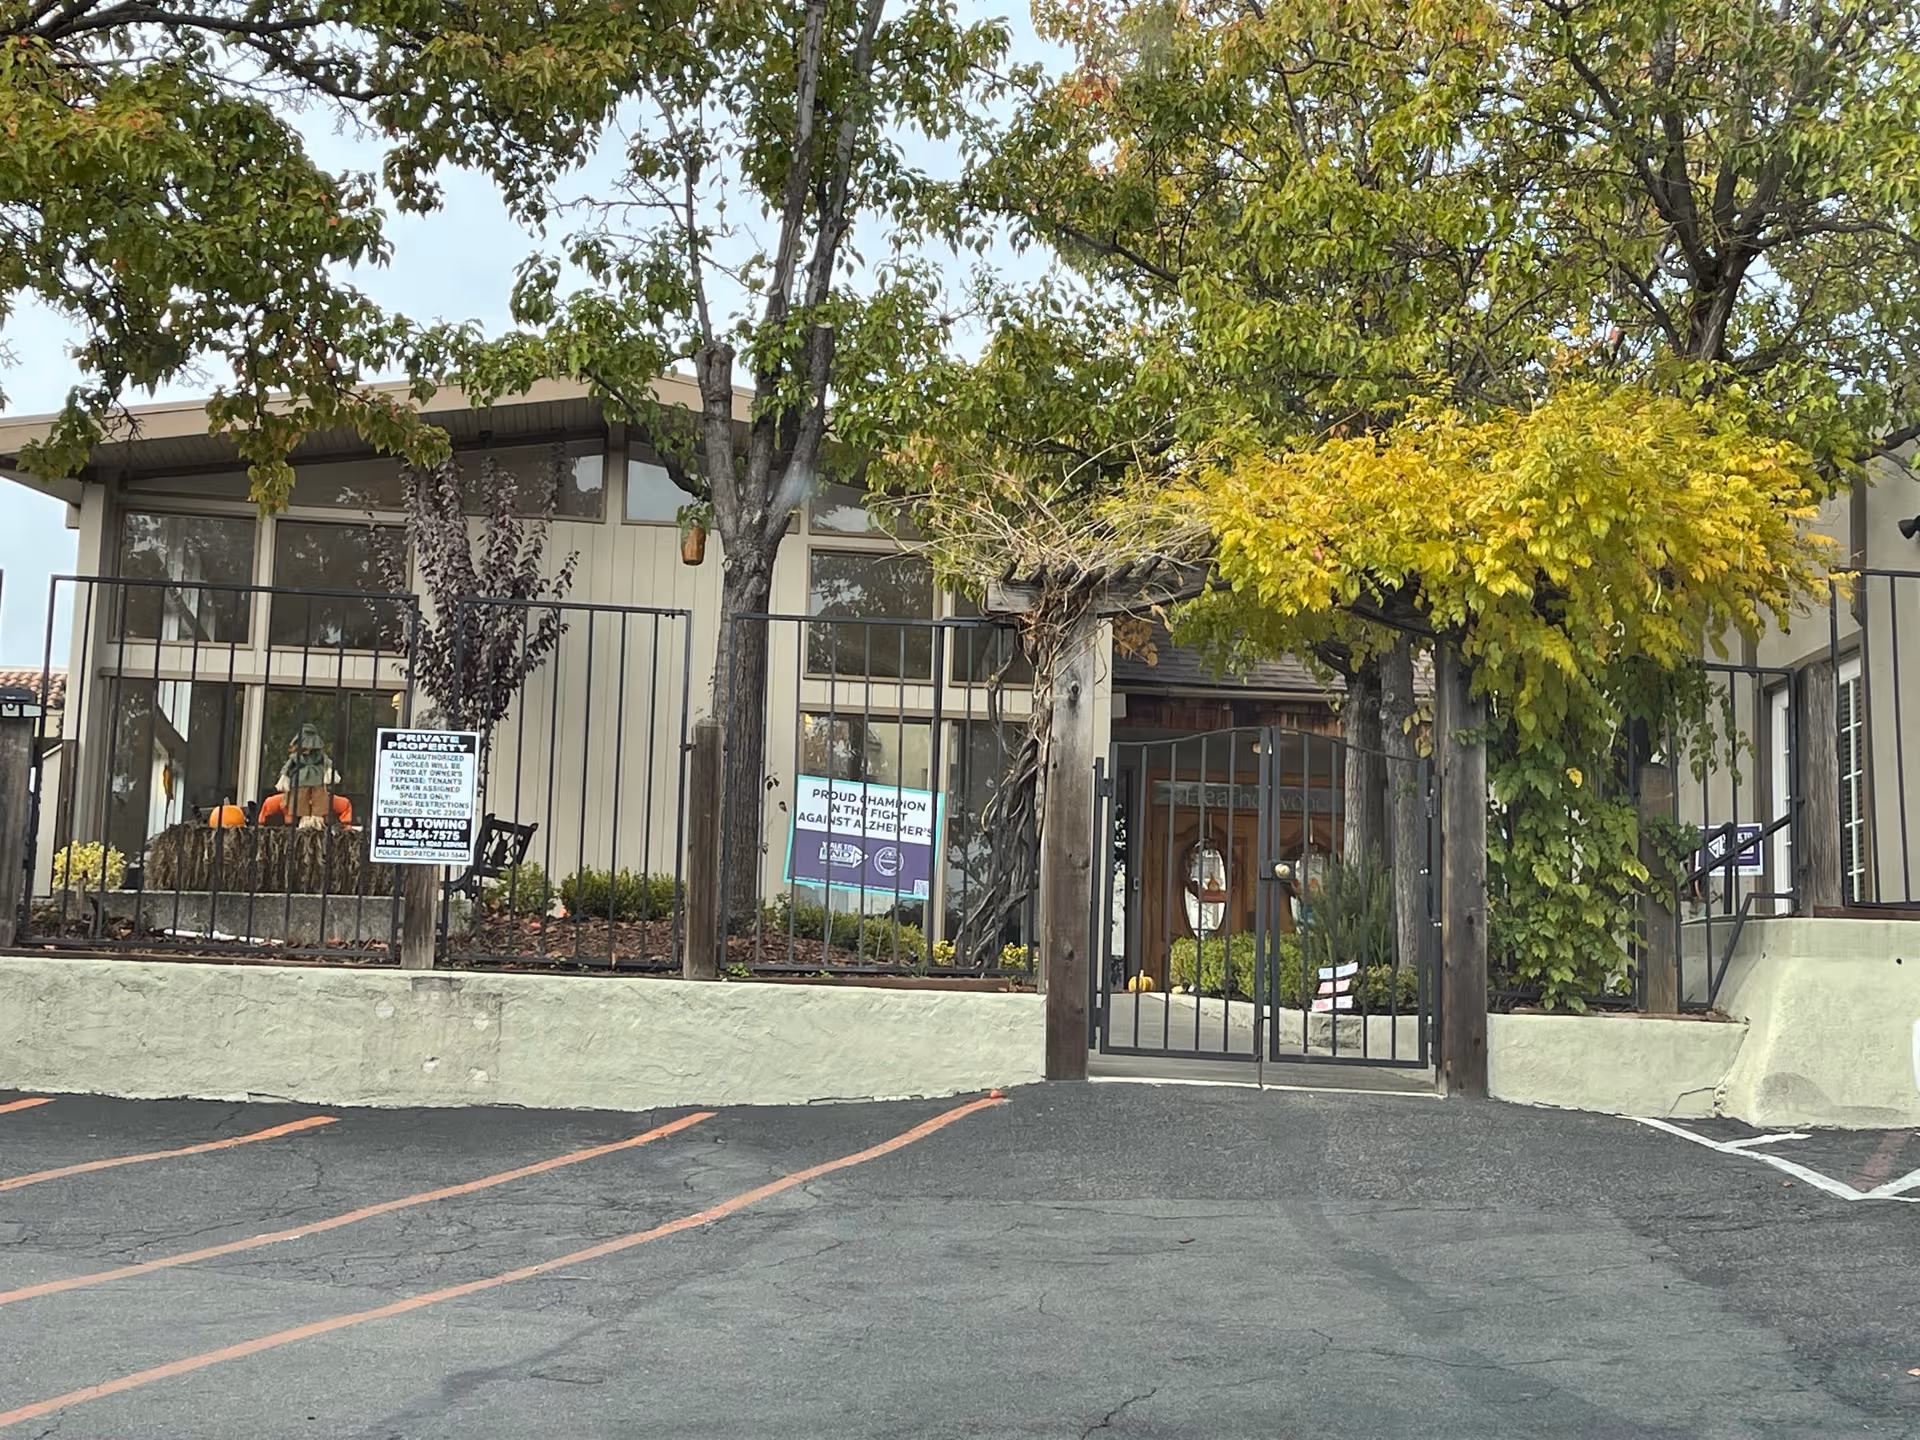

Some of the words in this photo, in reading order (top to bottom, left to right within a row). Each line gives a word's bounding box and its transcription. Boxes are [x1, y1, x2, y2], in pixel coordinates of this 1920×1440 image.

[396, 734, 459, 743] PRIVATE
[387, 741, 468, 752] PROPERTY
[406, 754, 464, 762] UNAUTHORIZED
[812, 788, 857, 802] PROUD
[415, 800, 470, 809] RESTRICTIONS
[871, 809, 908, 821] FIGHT
[380, 817, 389, 827] B
[391, 818, 401, 827] &
[403, 818, 413, 828] D
[415, 818, 467, 830] TOWING
[798, 812, 852, 827] AGAINST
[853, 820, 933, 837] AZHEIMER'S
